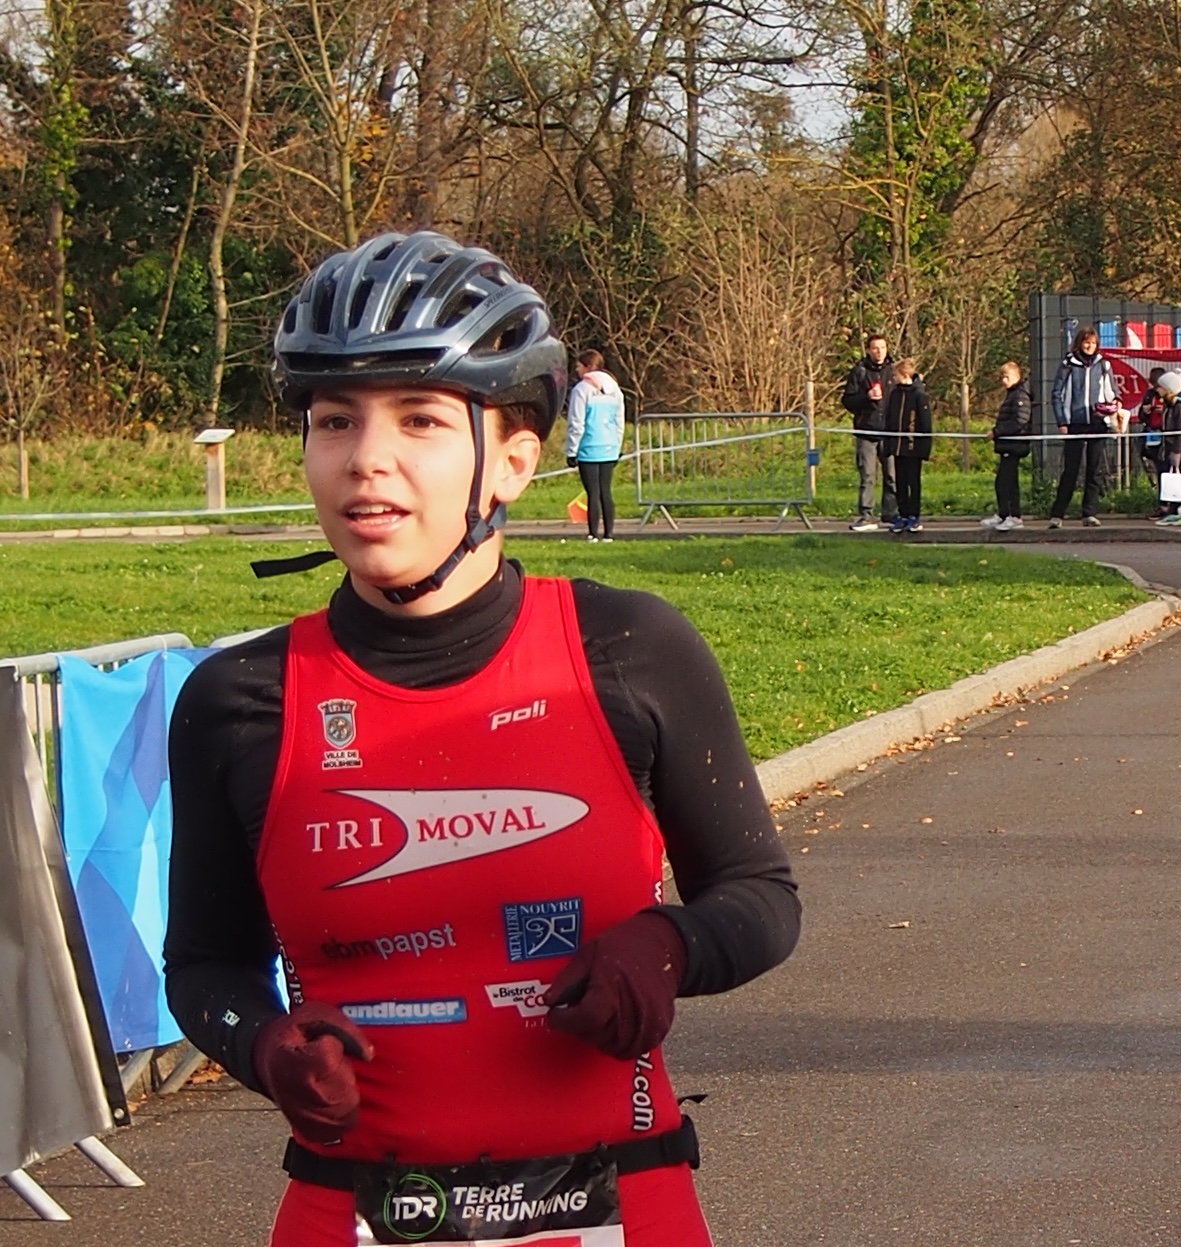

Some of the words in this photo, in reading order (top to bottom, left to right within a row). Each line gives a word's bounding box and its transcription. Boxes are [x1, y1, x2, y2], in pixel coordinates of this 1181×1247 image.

[1112, 373, 1142, 395] RI
[491, 699, 547, 731] poli
[306, 817, 384, 852] TRI
[417, 805, 546, 842] MOVAL
[520, 899, 581, 914] NOUYRIT
[499, 986, 536, 998] Bistrot
[453, 1183, 524, 1205] TERRE
[392, 1195, 437, 1221] TDR
[461, 1204, 484, 1220] DE
